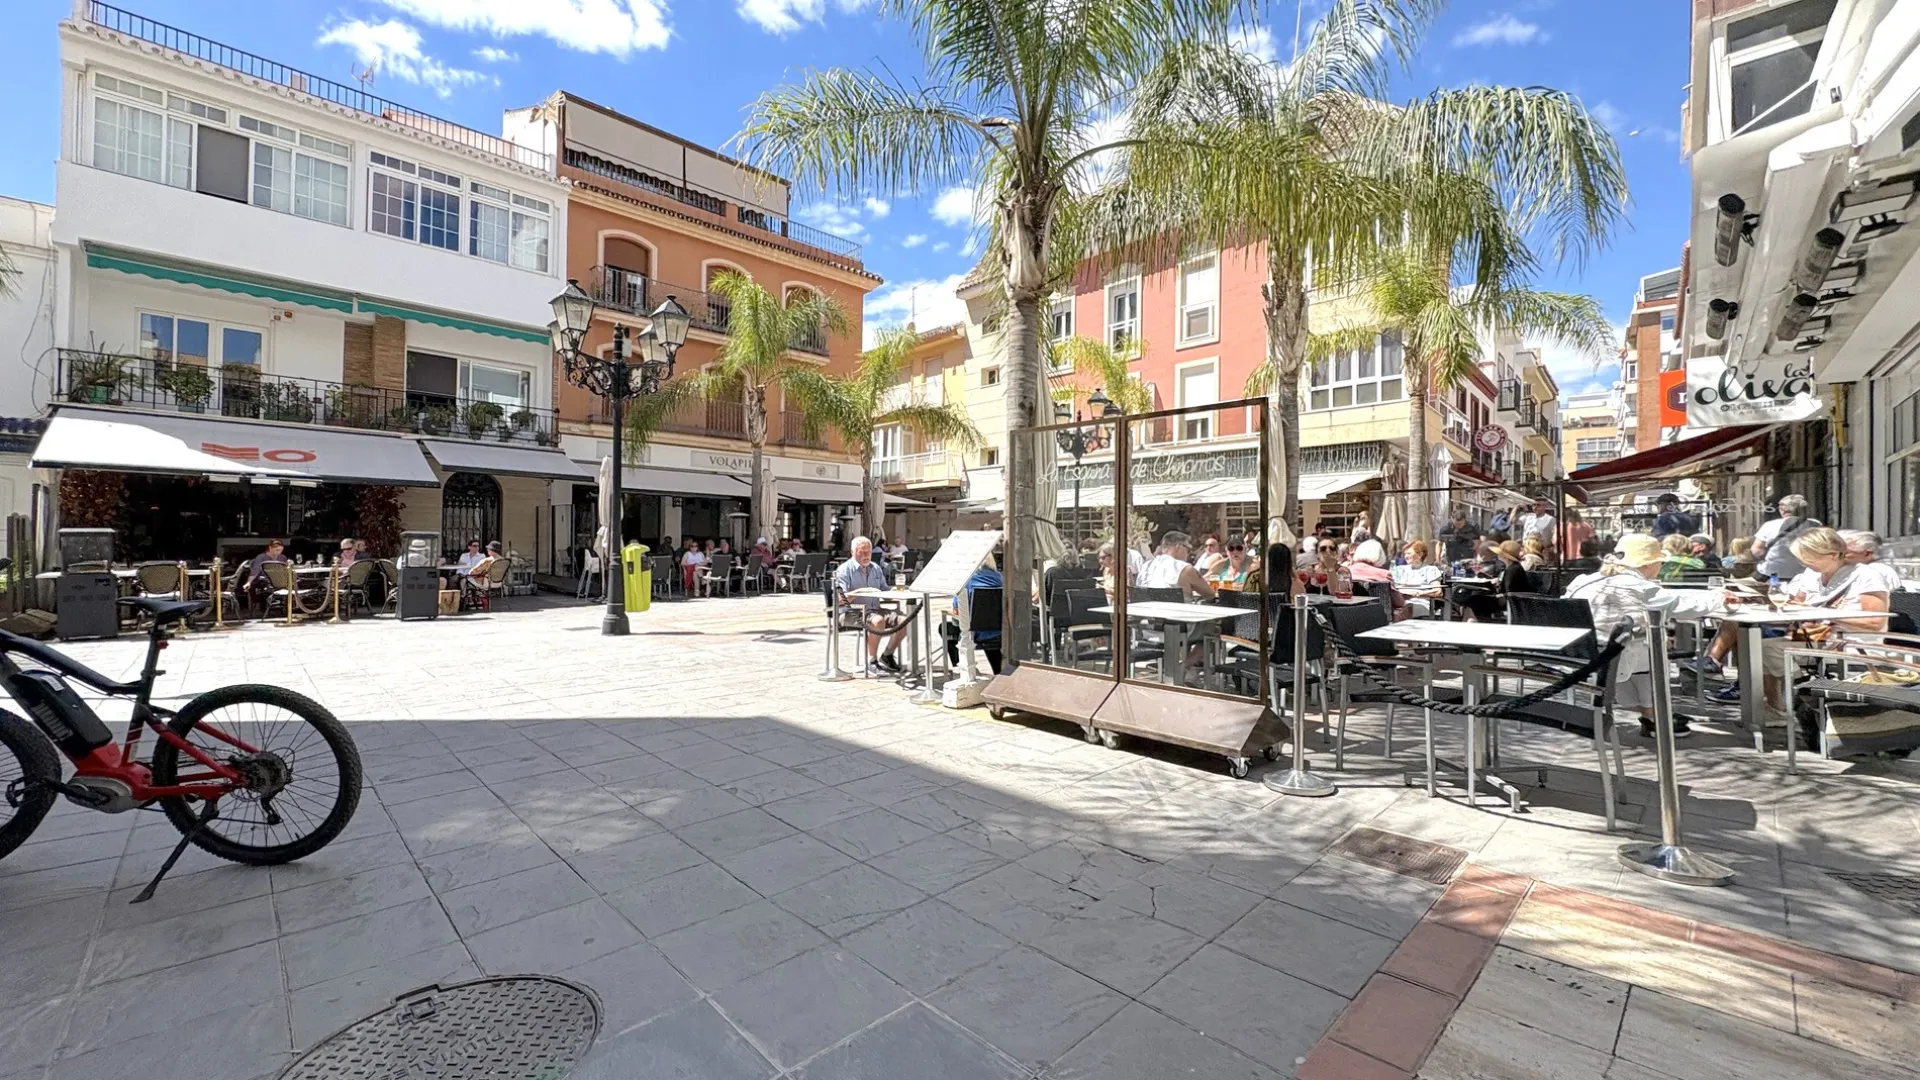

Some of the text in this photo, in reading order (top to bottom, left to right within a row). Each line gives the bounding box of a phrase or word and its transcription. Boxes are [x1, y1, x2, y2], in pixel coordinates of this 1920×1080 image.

[1694, 366, 1811, 405] oliva
[709, 456, 752, 470] VOLAPI
[1064, 463, 1110, 487] Esquina
[1130, 458, 1147, 478] de
